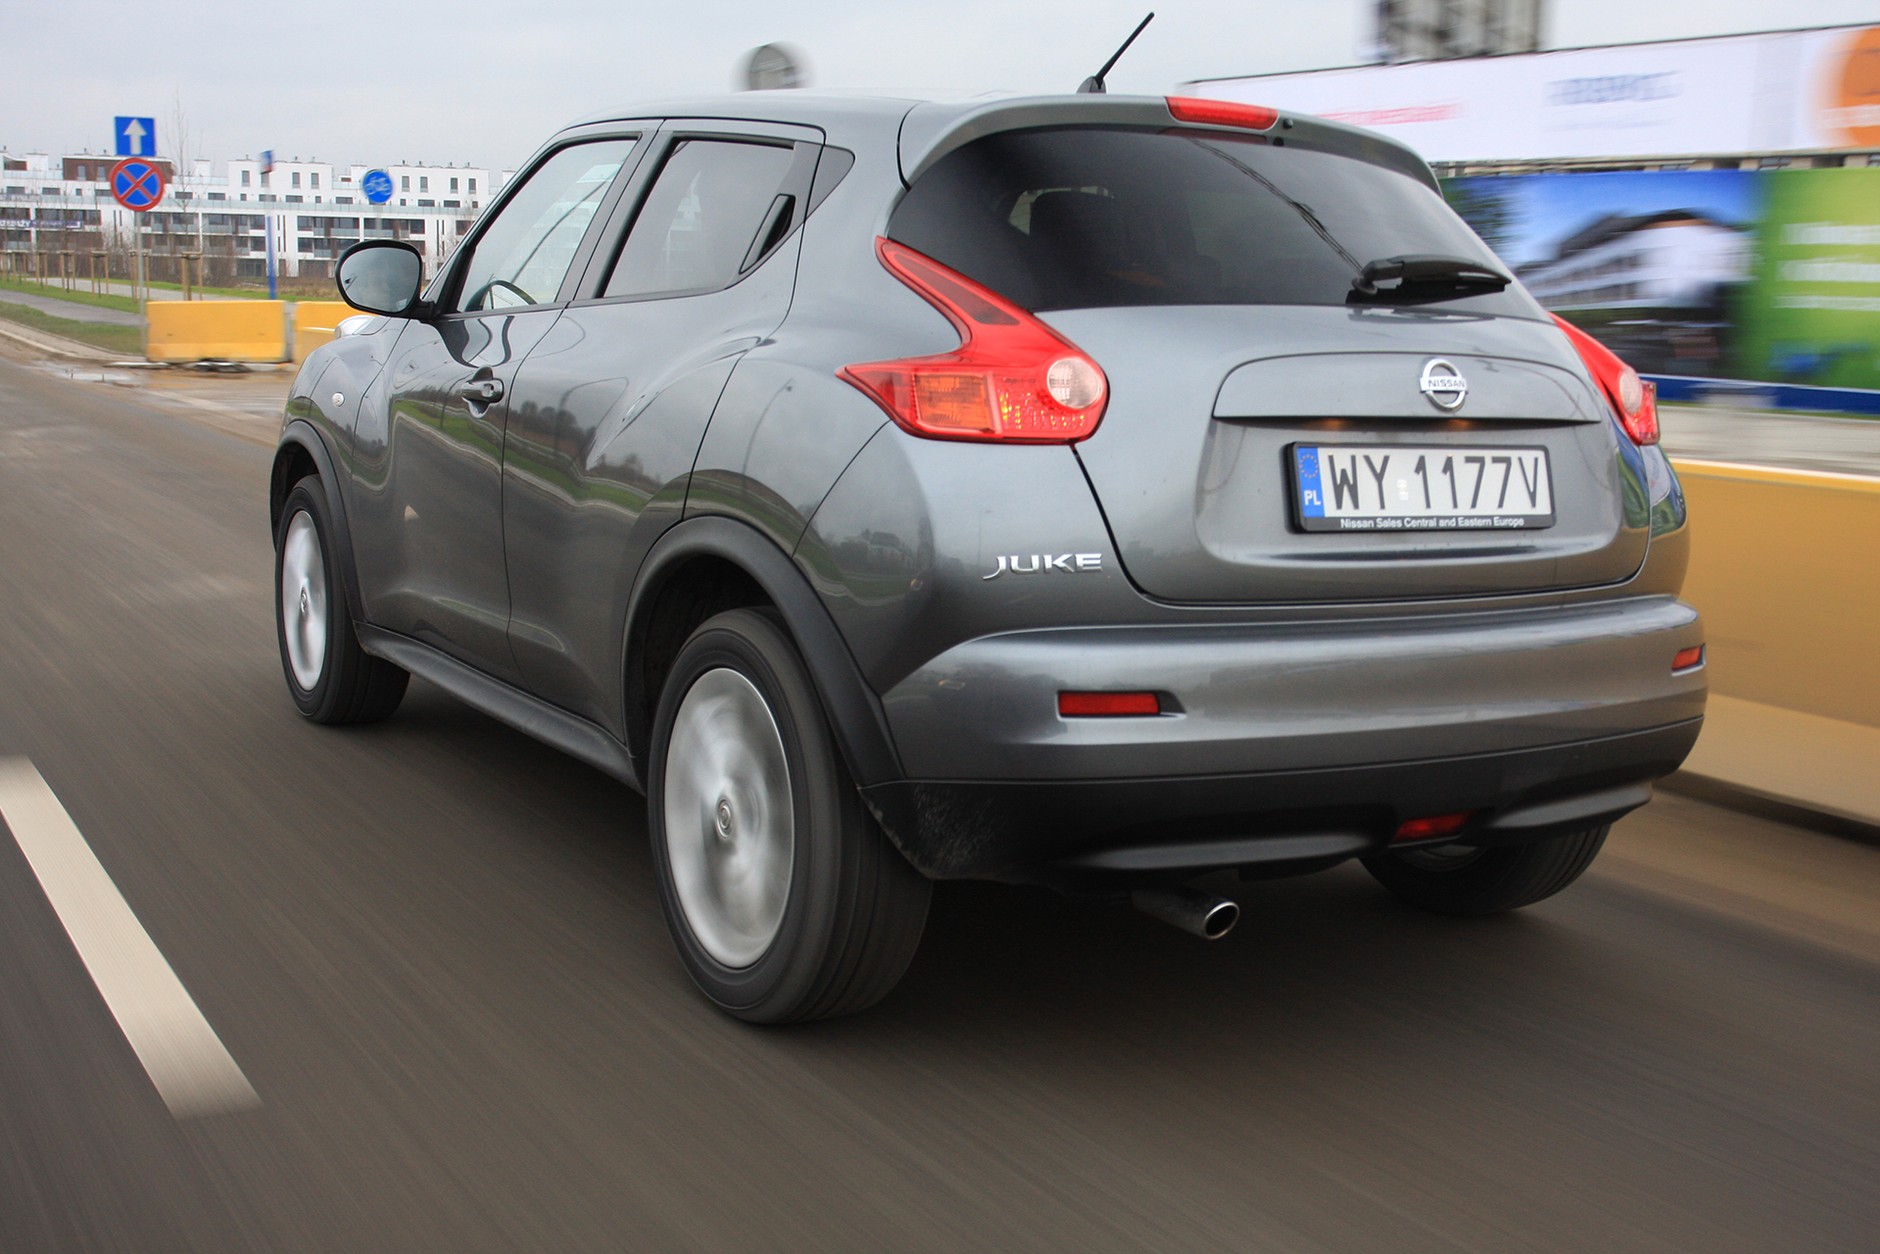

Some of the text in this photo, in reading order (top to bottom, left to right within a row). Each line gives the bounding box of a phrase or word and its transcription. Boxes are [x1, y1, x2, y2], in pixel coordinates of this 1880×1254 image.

[1428, 379, 1465, 388] NISSAN
[1328, 454, 1539, 510] WY 1177V
[1304, 489, 1321, 505] PL
[1341, 516, 1524, 528] Nissan Sales Central and Eastern Europe
[982, 553, 1102, 580] JUKE
